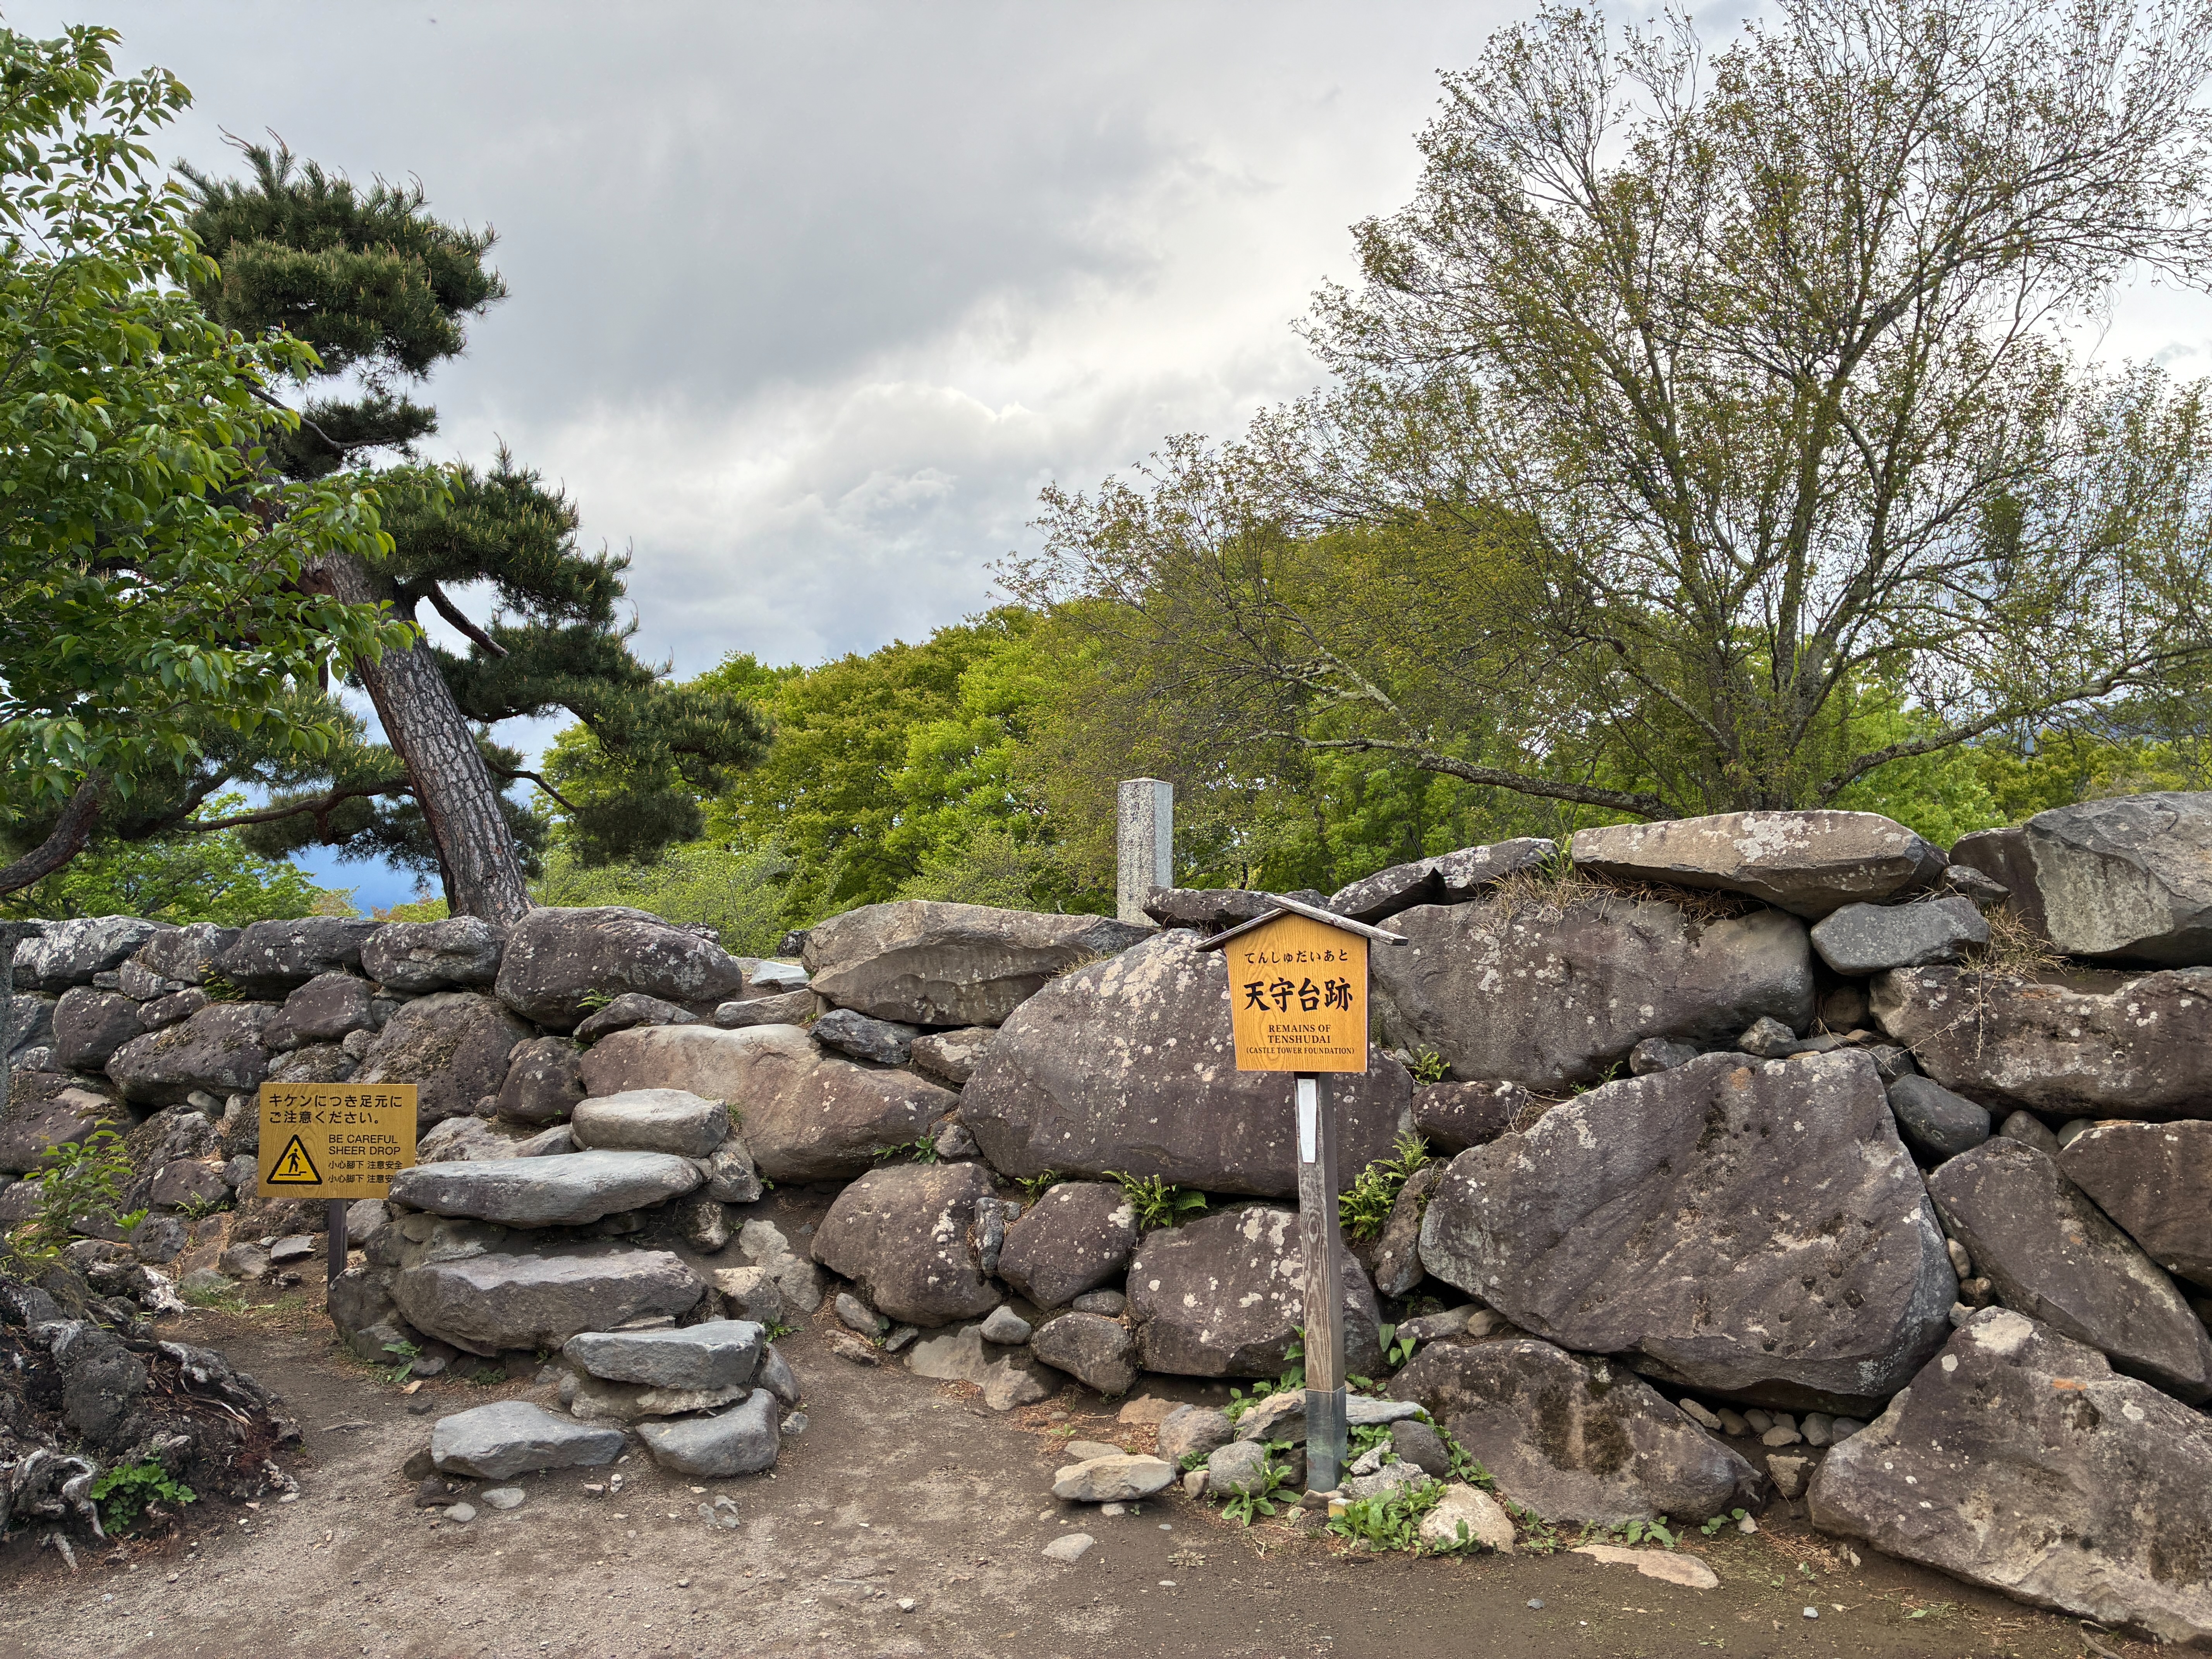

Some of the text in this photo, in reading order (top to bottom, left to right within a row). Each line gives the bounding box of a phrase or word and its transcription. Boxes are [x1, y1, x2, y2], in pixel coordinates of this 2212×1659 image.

[1244, 949, 1348, 964] てんしゅだいあと
[1243, 977, 1353, 1013] 天守台跡
[1268, 1024, 1331, 1032] REMAINS OF
[1267, 1035, 1331, 1043] TENSHUDAI
[269, 1093, 402, 1108] キケンにつき足元に
[270, 1110, 378, 1124] ご注意ください。
[329, 1134, 398, 1144] BE CAREFUL
[329, 1146, 401, 1155] SHEER DROP
[367, 1161, 403, 1170] 注意安全
[328, 1174, 394, 1183] 小心脚下 注意安
